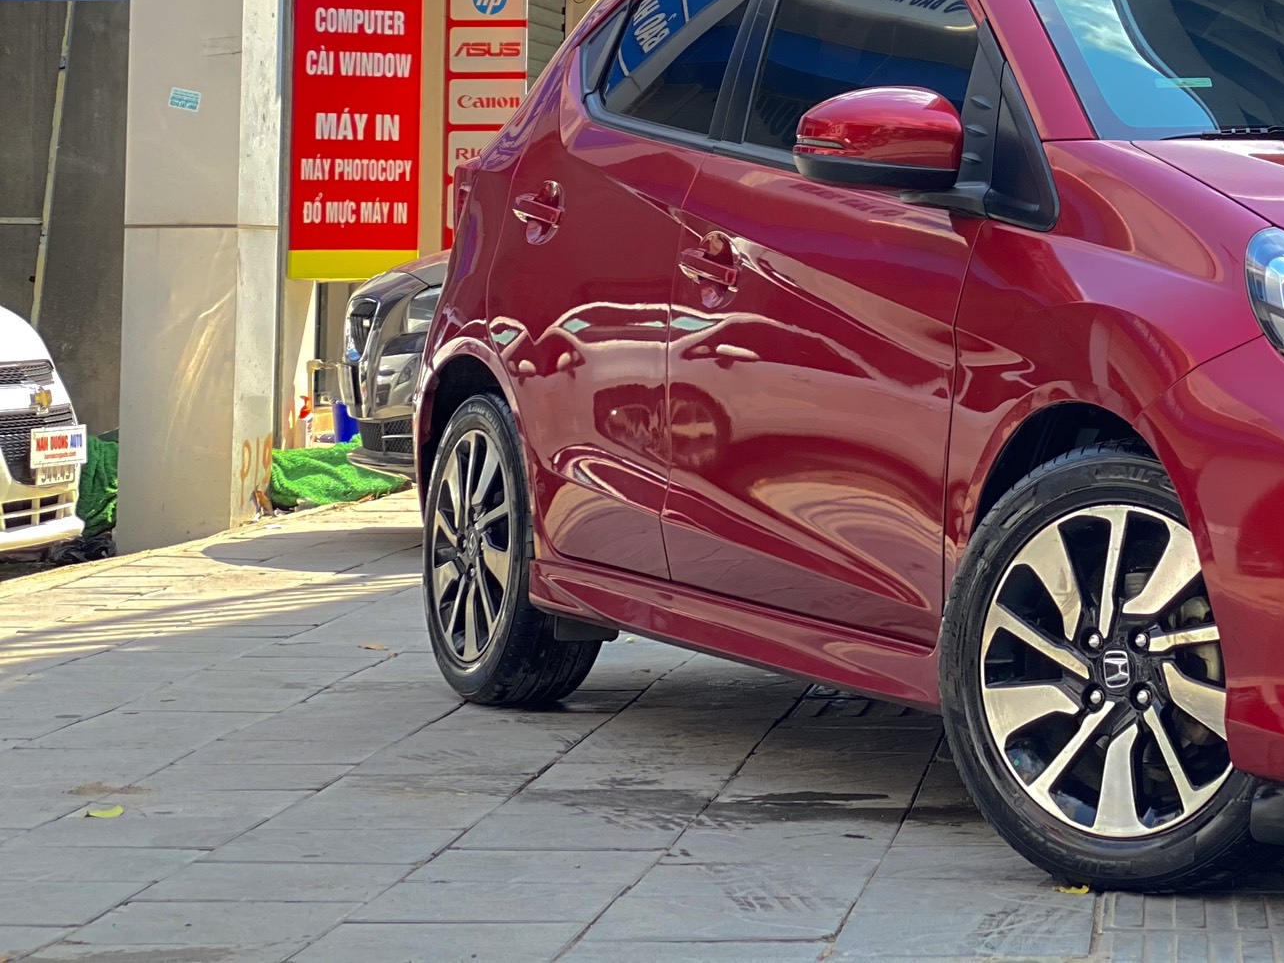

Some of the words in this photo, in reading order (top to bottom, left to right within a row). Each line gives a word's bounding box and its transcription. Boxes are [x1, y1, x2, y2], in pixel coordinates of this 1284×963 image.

[315, 7, 405, 35] COMPUTER
[306, 45, 334, 76] CÀI
[339, 51, 412, 78] WINDOW
[454, 42, 521, 57] ASUS
[457, 94, 520, 109] Canon
[315, 108, 368, 141] MÁY
[375, 114, 400, 141] IN
[301, 153, 331, 181] MÁY
[334, 158, 412, 182] PHOTOCOPY
[303, 192, 323, 224] ĐỔ
[325, 199, 357, 229] MỰC
[360, 197, 390, 224] MÁY
[393, 202, 408, 224] IN
